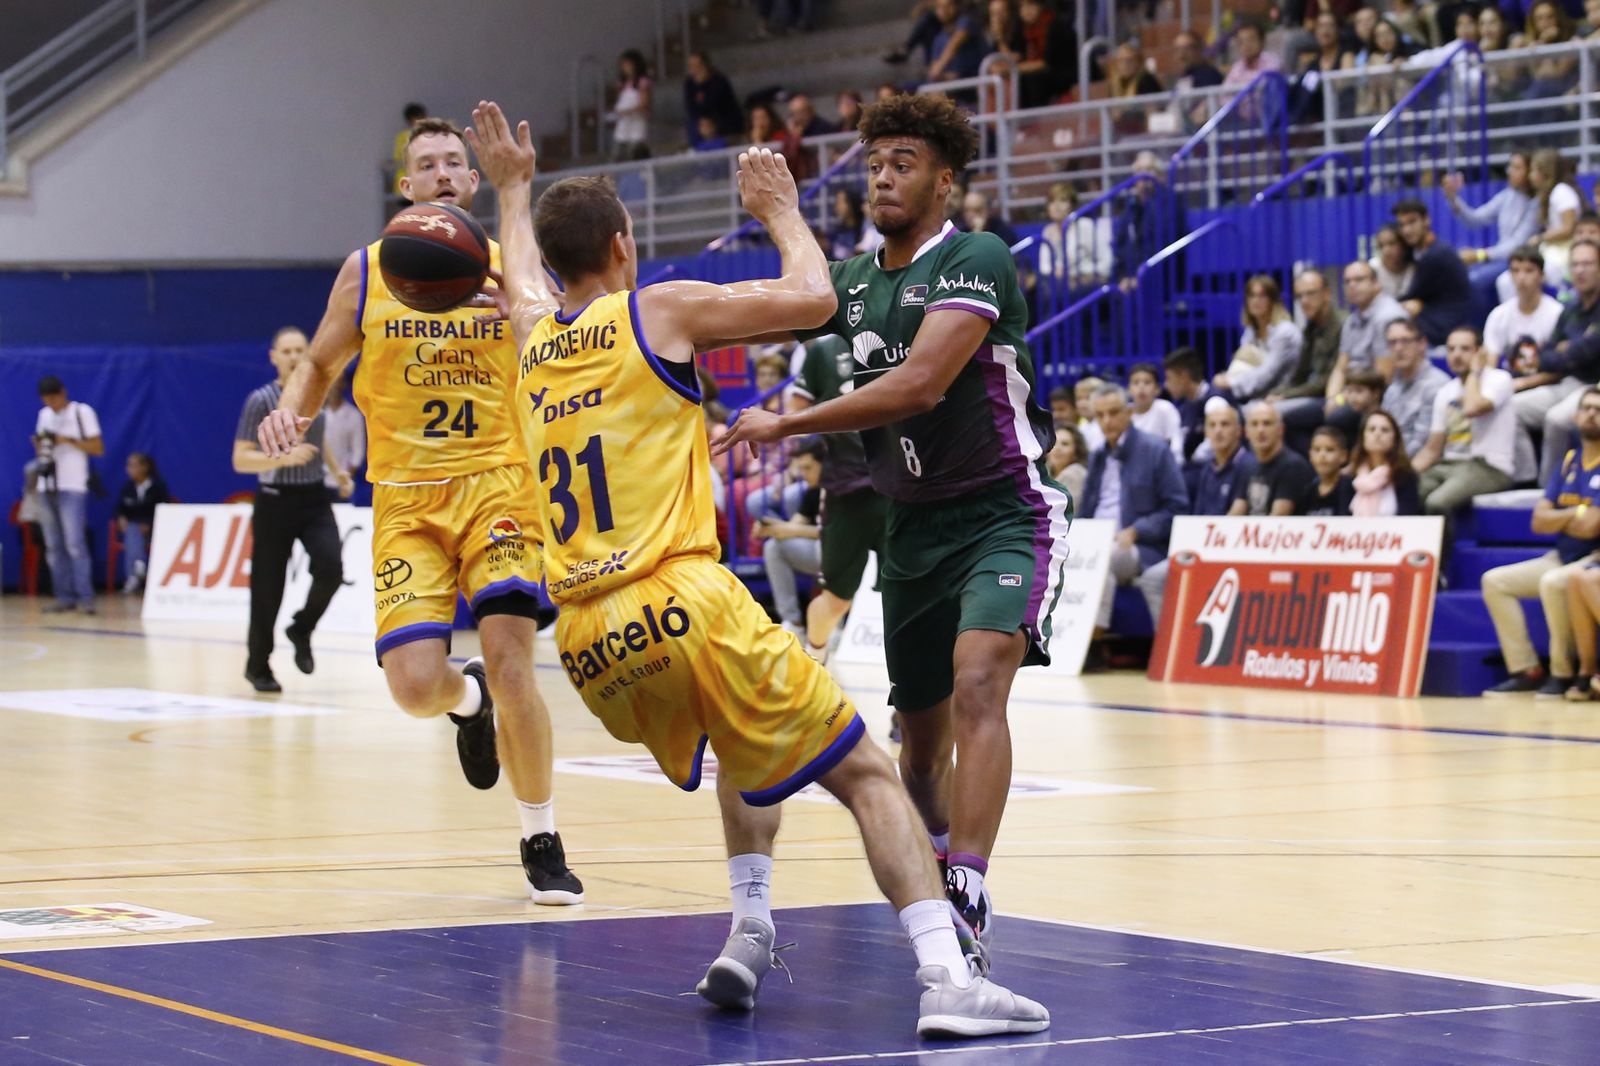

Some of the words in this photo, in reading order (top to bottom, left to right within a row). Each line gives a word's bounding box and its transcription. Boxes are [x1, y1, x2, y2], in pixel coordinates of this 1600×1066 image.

[385, 319, 503, 340] HERBALIFE
[416, 342, 475, 365] Gran
[404, 364, 492, 387] Canaria
[423, 400, 479, 438] 24
[900, 436, 922, 478] 8
[539, 434, 615, 546] 31
[1204, 523, 1228, 547] Tu
[1236, 524, 1302, 552] Mejor
[1311, 524, 1402, 557] Imagen
[376, 591, 417, 611] OYOTA
[560, 596, 690, 689] Barceló
[1306, 661, 1320, 687] y
[1323, 653, 1378, 684] Vinilos
